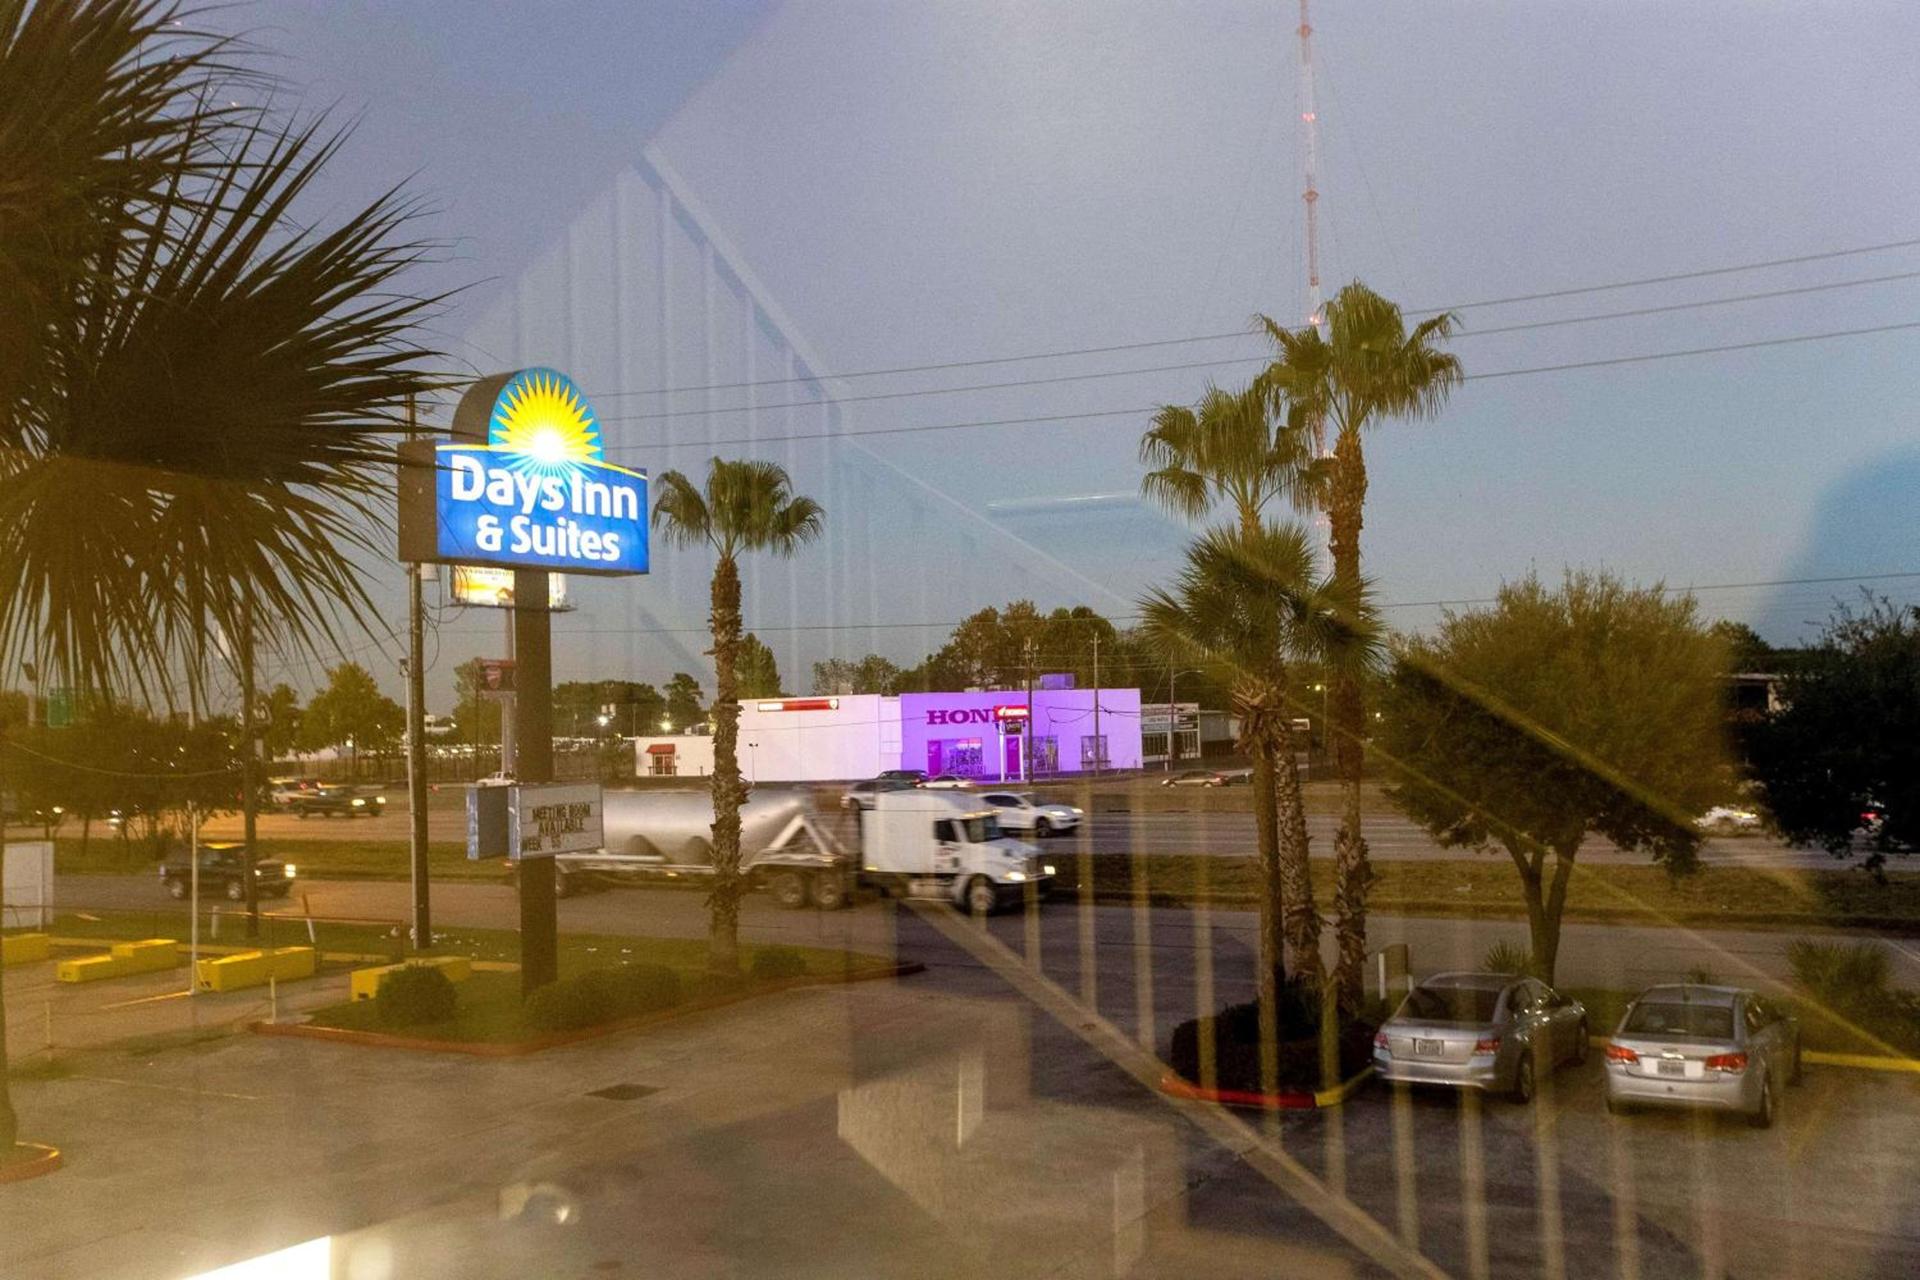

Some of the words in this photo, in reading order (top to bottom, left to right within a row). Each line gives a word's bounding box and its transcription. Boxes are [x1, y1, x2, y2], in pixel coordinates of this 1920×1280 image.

[451, 454, 564, 515] Days
[570, 470, 639, 521] Inn
[475, 514, 504, 552] &
[510, 515, 621, 561] Suites
[926, 709, 1002, 725] HON
[532, 804, 567, 823] MEETING
